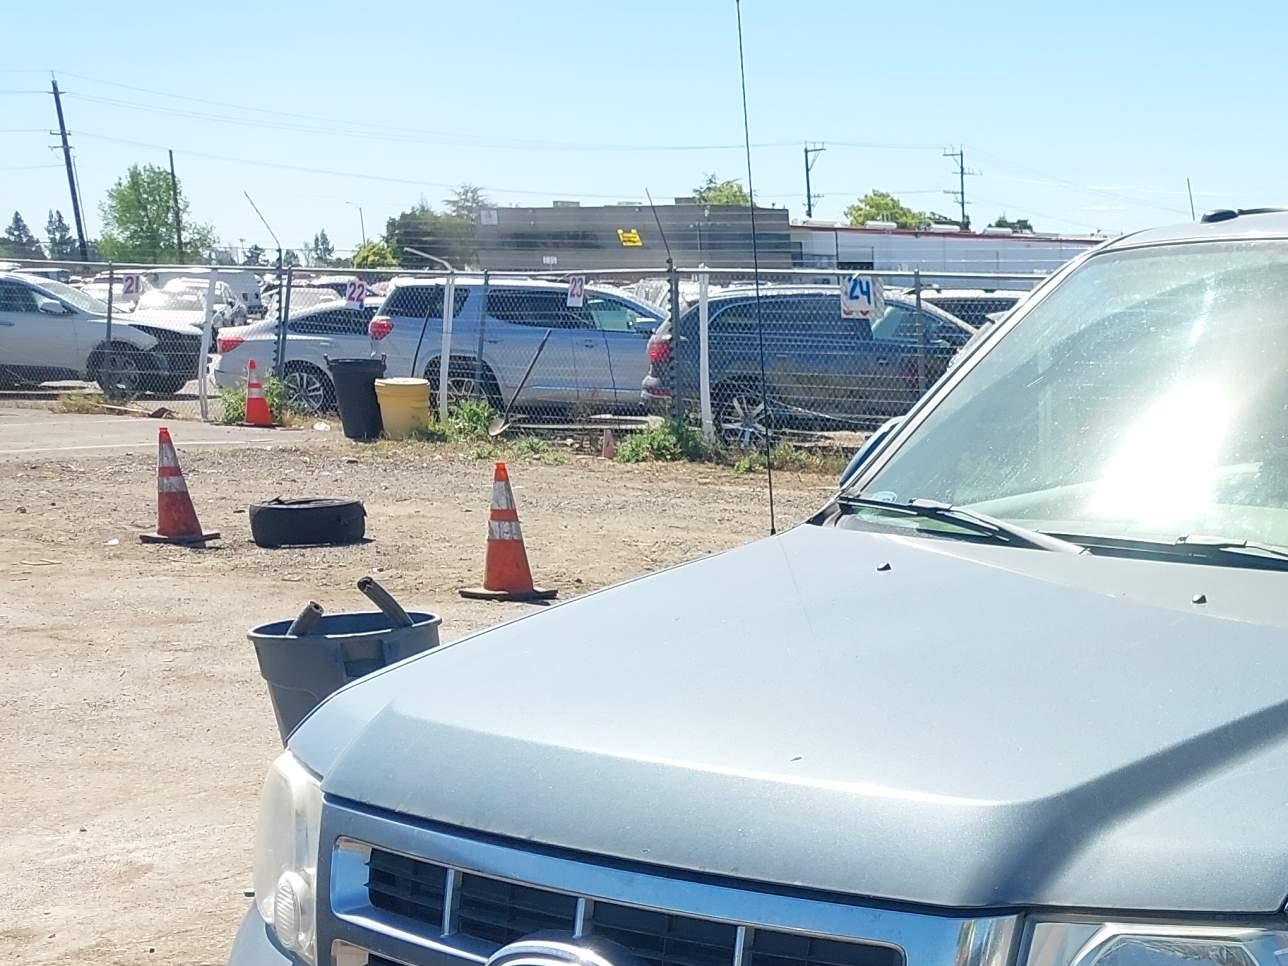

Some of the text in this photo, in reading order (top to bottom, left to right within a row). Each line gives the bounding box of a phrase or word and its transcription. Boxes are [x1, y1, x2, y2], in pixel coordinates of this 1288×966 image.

[124, 275, 140, 294] 21
[347, 282, 365, 303] 22
[848, 275, 871, 305] 24
